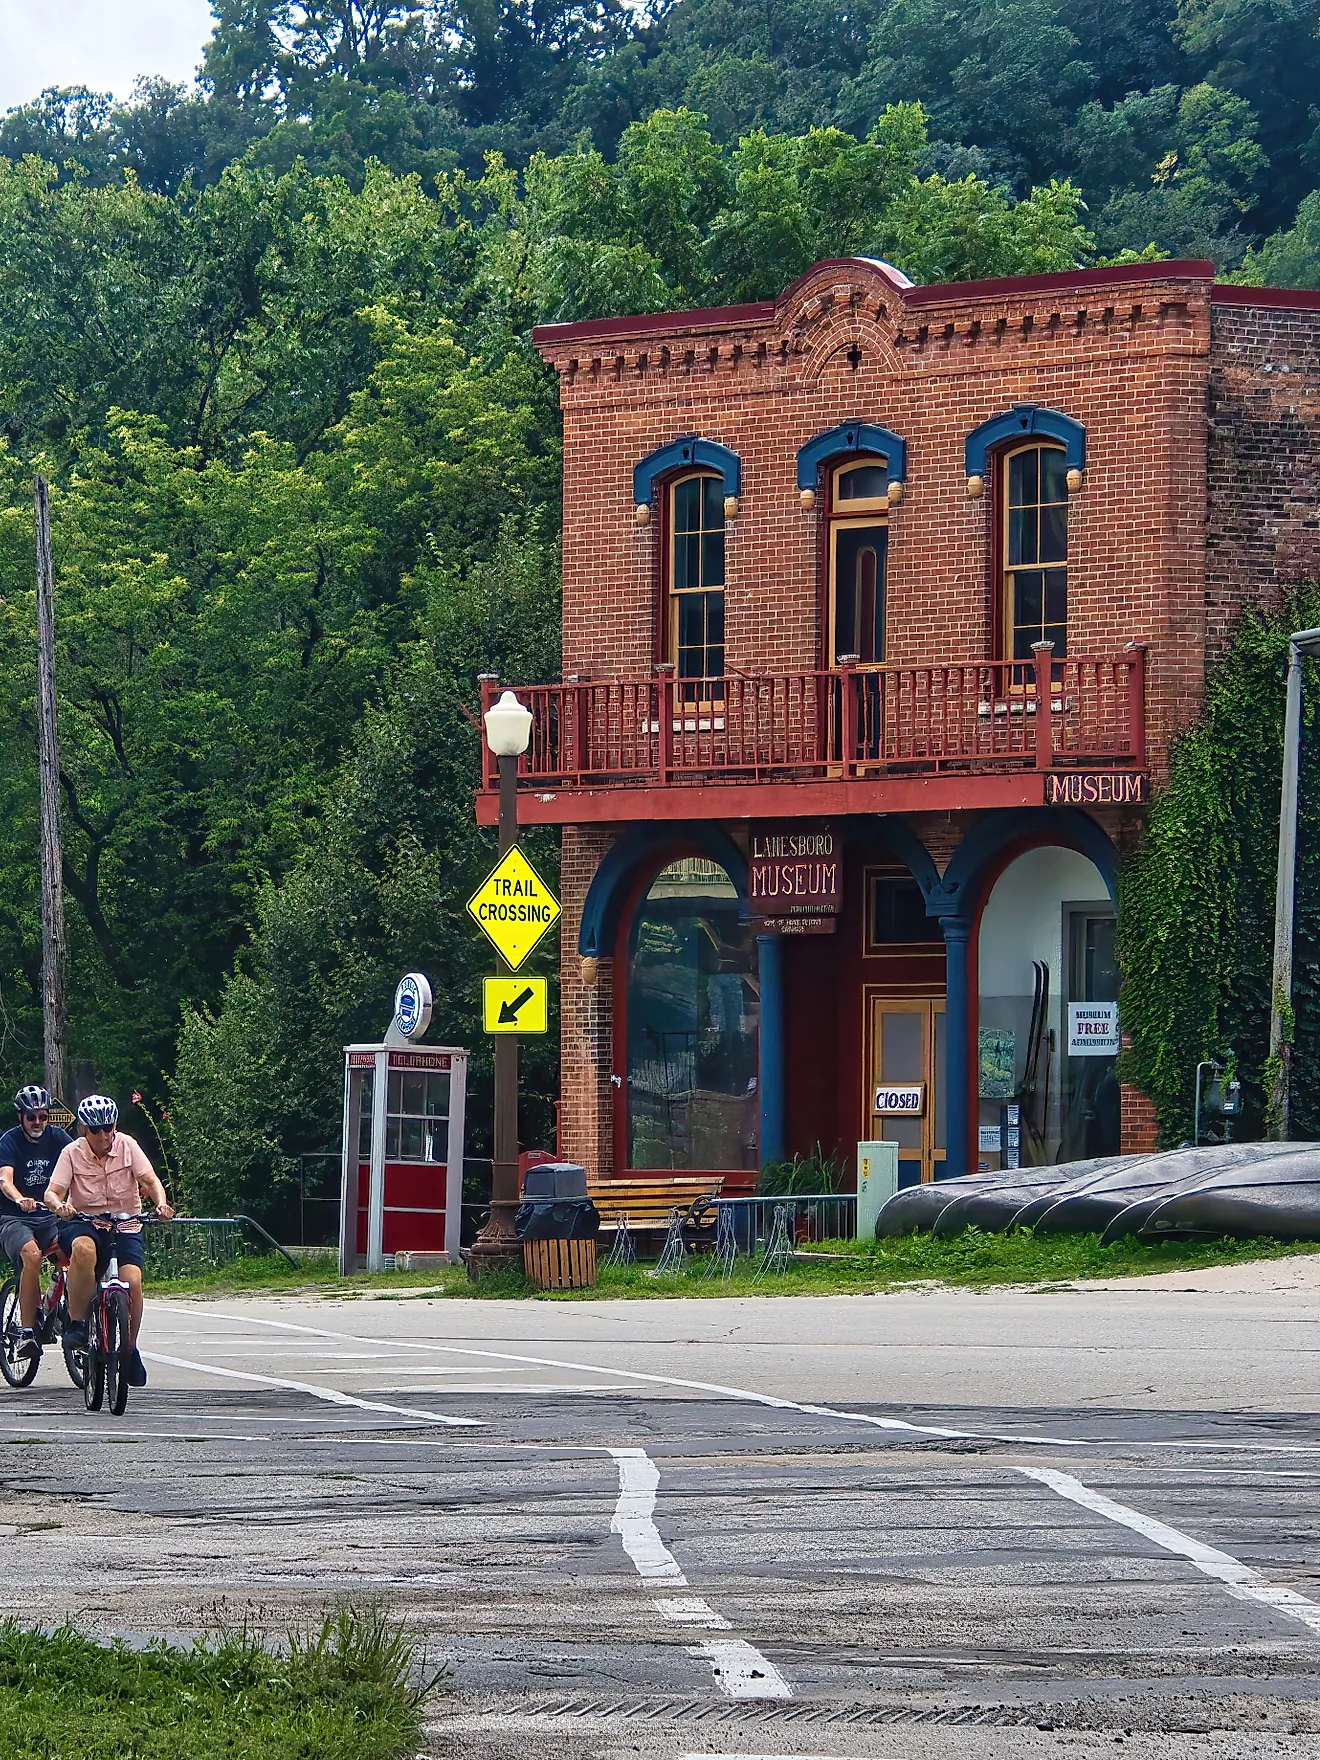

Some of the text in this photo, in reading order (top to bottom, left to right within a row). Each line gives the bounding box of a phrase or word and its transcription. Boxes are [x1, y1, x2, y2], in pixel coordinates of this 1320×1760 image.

[1051, 775, 1142, 803] MUSEUM
[753, 834, 833, 858] LANESBORO
[494, 879, 538, 897] TRAIL
[752, 863, 836, 896] MUSEUM
[478, 903, 551, 923] CROSSING
[1077, 1022, 1110, 1035] FREE
[393, 1054, 448, 1067] TELEPHONE
[876, 1092, 919, 1109] CLOSED
